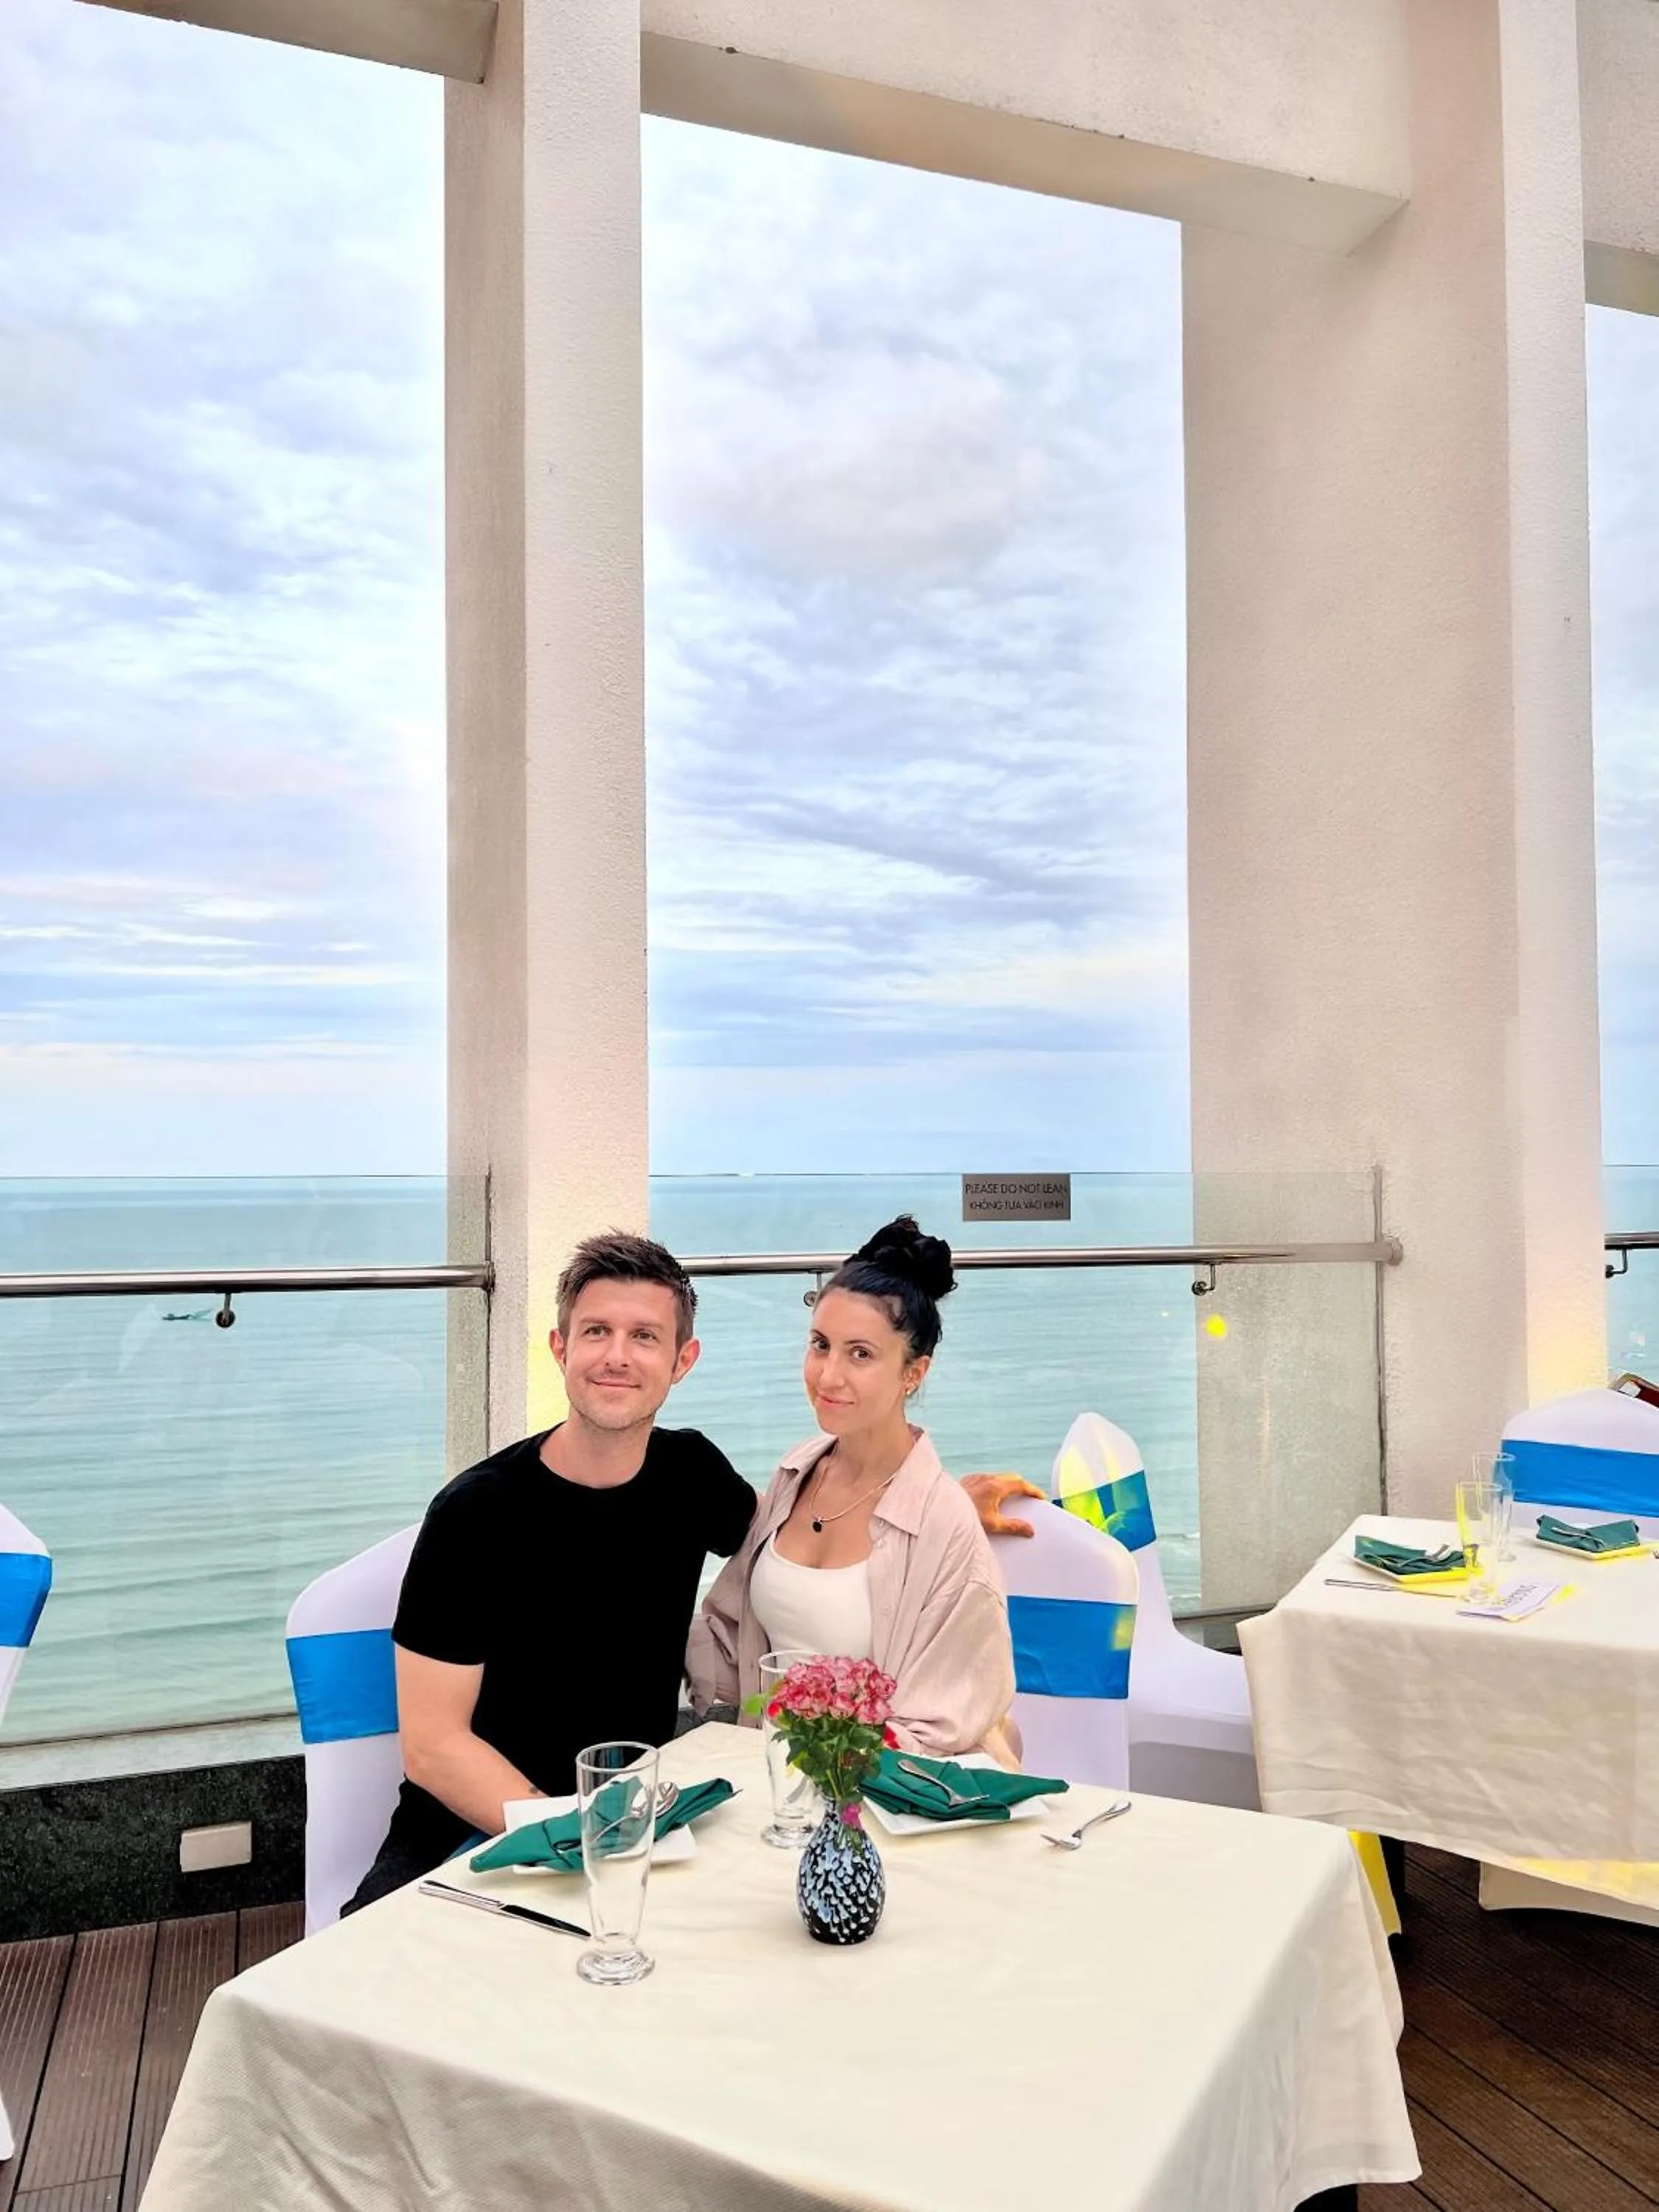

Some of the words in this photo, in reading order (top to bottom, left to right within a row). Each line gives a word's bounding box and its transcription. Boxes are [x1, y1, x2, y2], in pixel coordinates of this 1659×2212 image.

[965, 1183, 999, 1194] PLEASE
[1001, 1183, 1017, 1194] DO
[1019, 1183, 1040, 1194] NOT
[1043, 1183, 1067, 1194] LEAN
